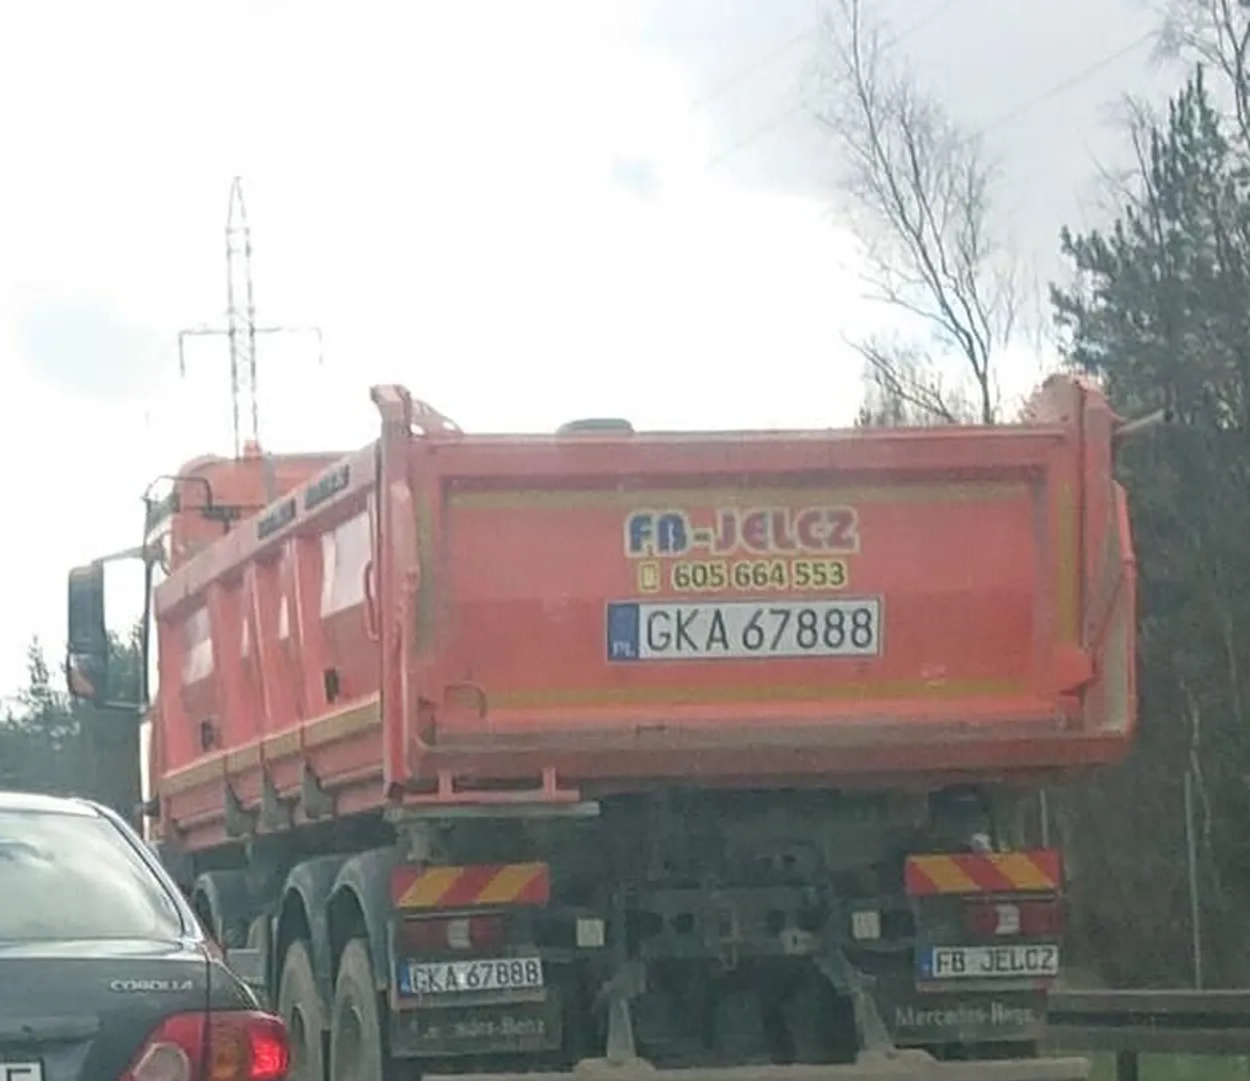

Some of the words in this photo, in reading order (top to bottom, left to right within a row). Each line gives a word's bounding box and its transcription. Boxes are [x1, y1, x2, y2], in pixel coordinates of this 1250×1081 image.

[674, 564, 724, 588] 605
[734, 563, 784, 587] 664
[794, 562, 845, 586] 553
[646, 609, 730, 651] GKA
[741, 608, 873, 651] 67888
[413, 966, 458, 992] GKA
[466, 960, 539, 987] 67888
[935, 951, 965, 973] FB
